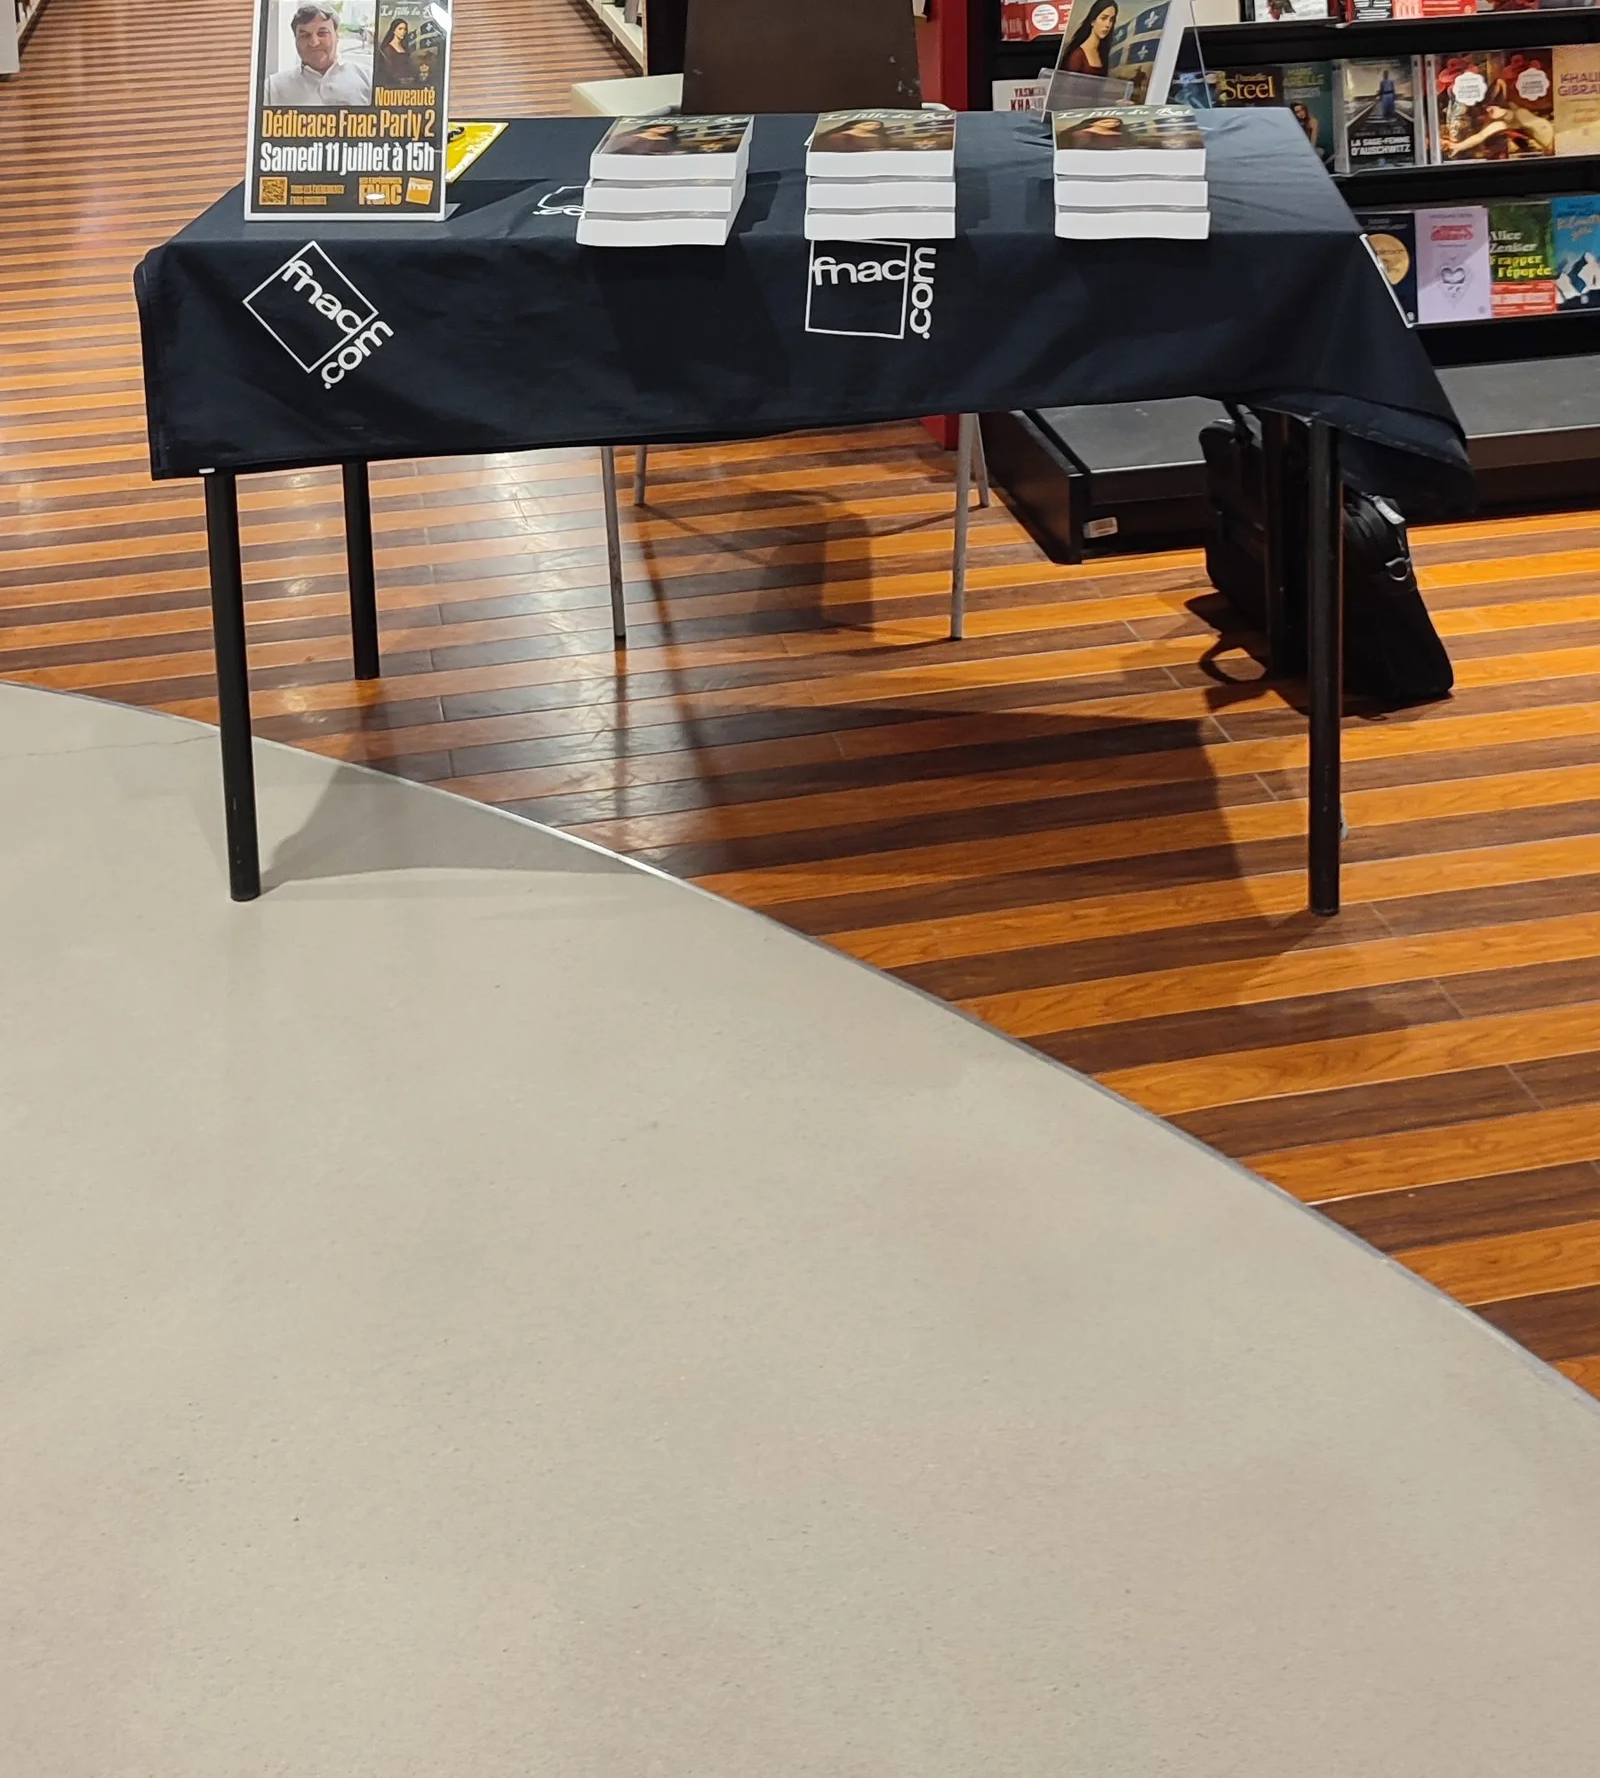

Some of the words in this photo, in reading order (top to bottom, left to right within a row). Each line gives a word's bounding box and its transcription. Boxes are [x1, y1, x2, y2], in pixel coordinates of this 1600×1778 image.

[375, 86, 436, 107] Nouveauté
[1220, 76, 1276, 100] Steel
[262, 109, 337, 138] Dédicace
[339, 111, 377, 138] Fnac
[380, 111, 422, 141] Parly
[425, 111, 436, 138] 2
[1351, 139, 1362, 147] LA
[1351, 144, 1411, 157] D'AUSCHWITZ
[260, 142, 323, 173] Samedi
[326, 142, 338, 172] 11
[339, 142, 391, 176] juillet
[392, 142, 405, 172] à
[406, 142, 435, 172] 15h
[359, 184, 402, 205] FNAC
[1490, 230, 1522, 241] Alice
[1490, 255, 1543, 267] Frapper
[281, 259, 363, 334] fnac
[813, 256, 910, 286] fnac
[910, 246, 937, 340] .com
[321, 320, 394, 389] .com
